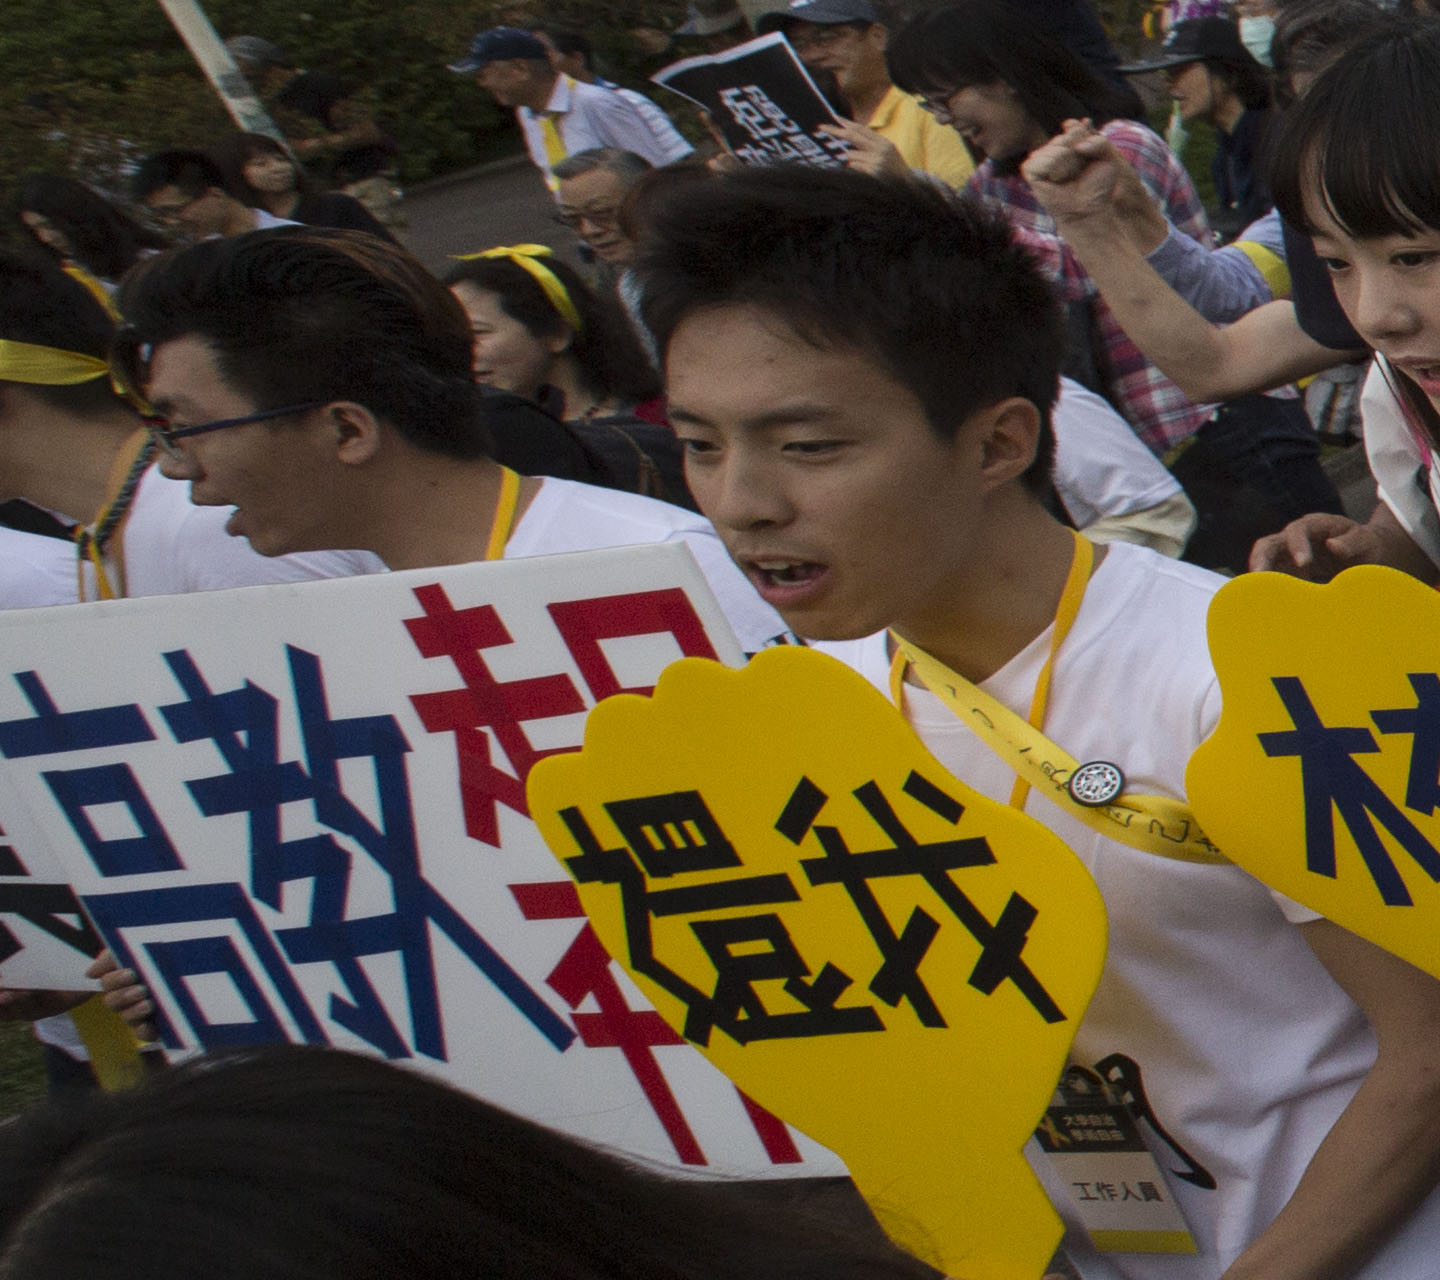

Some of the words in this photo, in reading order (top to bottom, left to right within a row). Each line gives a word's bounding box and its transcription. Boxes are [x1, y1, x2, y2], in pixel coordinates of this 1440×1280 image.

[0, 644, 575, 1065] 高教
[558, 770, 1067, 1047] 還我
[1071, 1181, 1164, 1203] 工作人員
